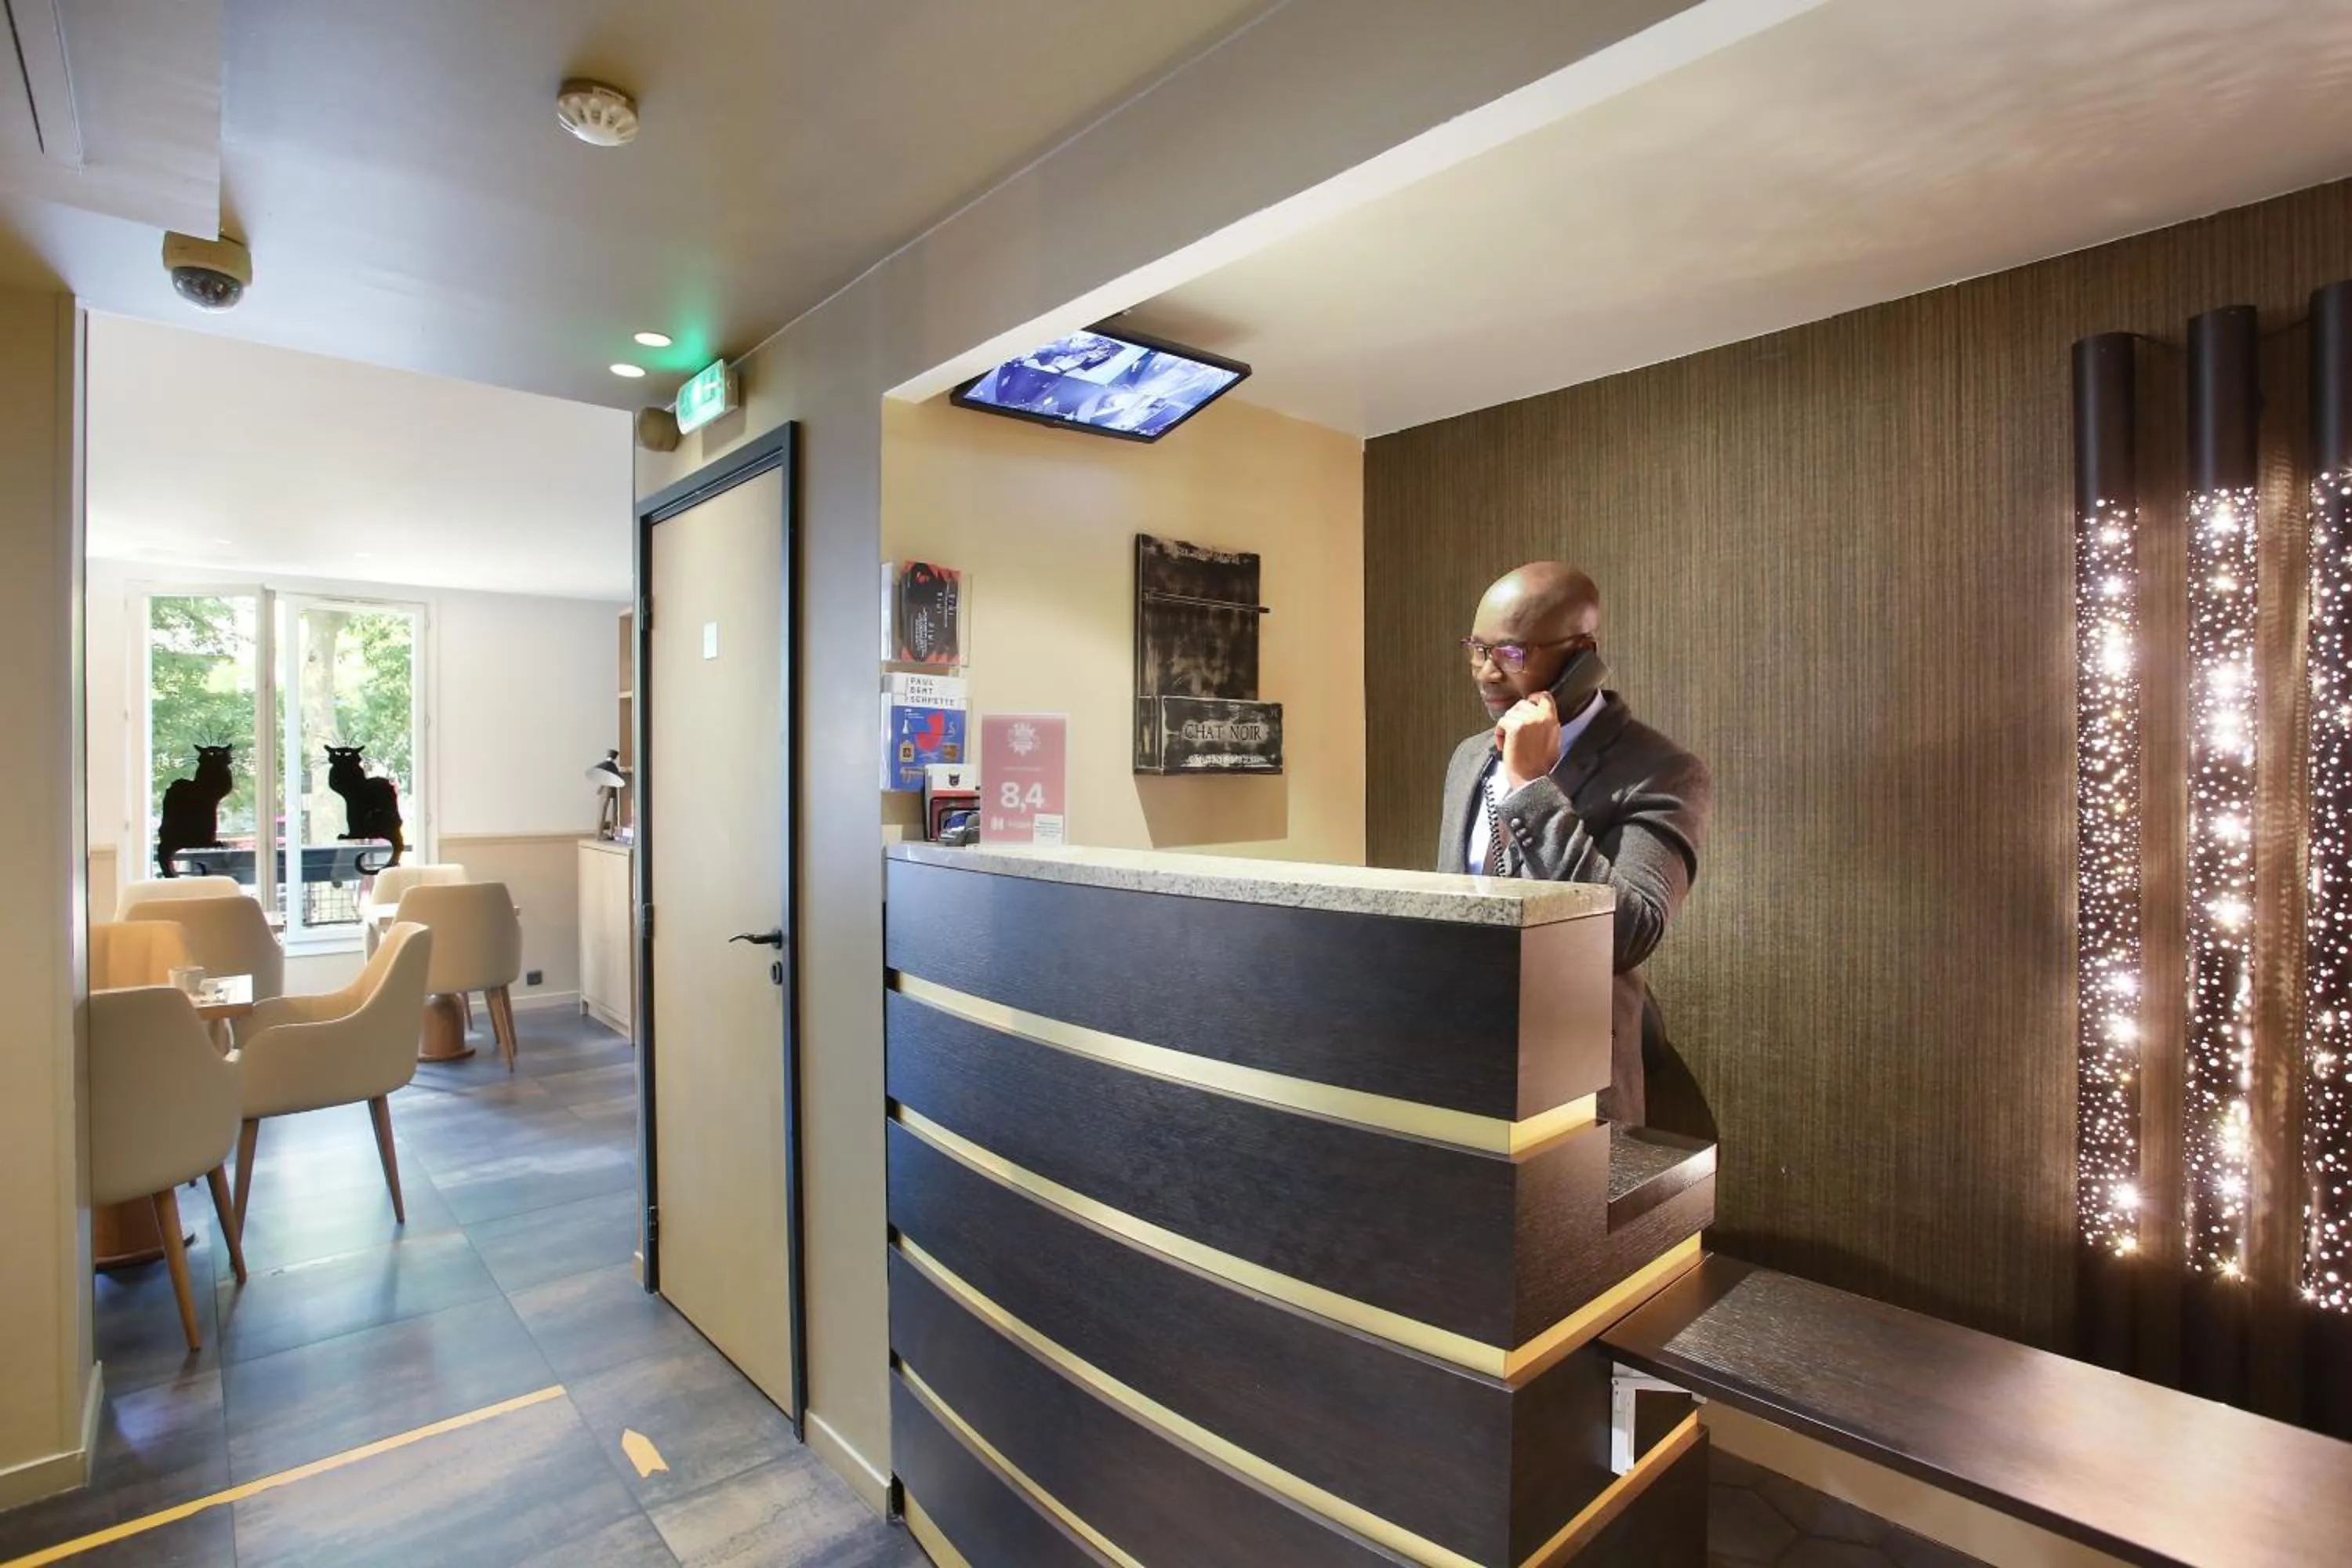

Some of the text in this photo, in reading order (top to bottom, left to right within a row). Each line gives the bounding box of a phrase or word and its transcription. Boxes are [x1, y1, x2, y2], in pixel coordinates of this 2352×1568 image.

[909, 677, 934, 686] PAUL
[1185, 724, 1261, 741] CHAT NOIR
[1000, 781, 1045, 814] 8,4
